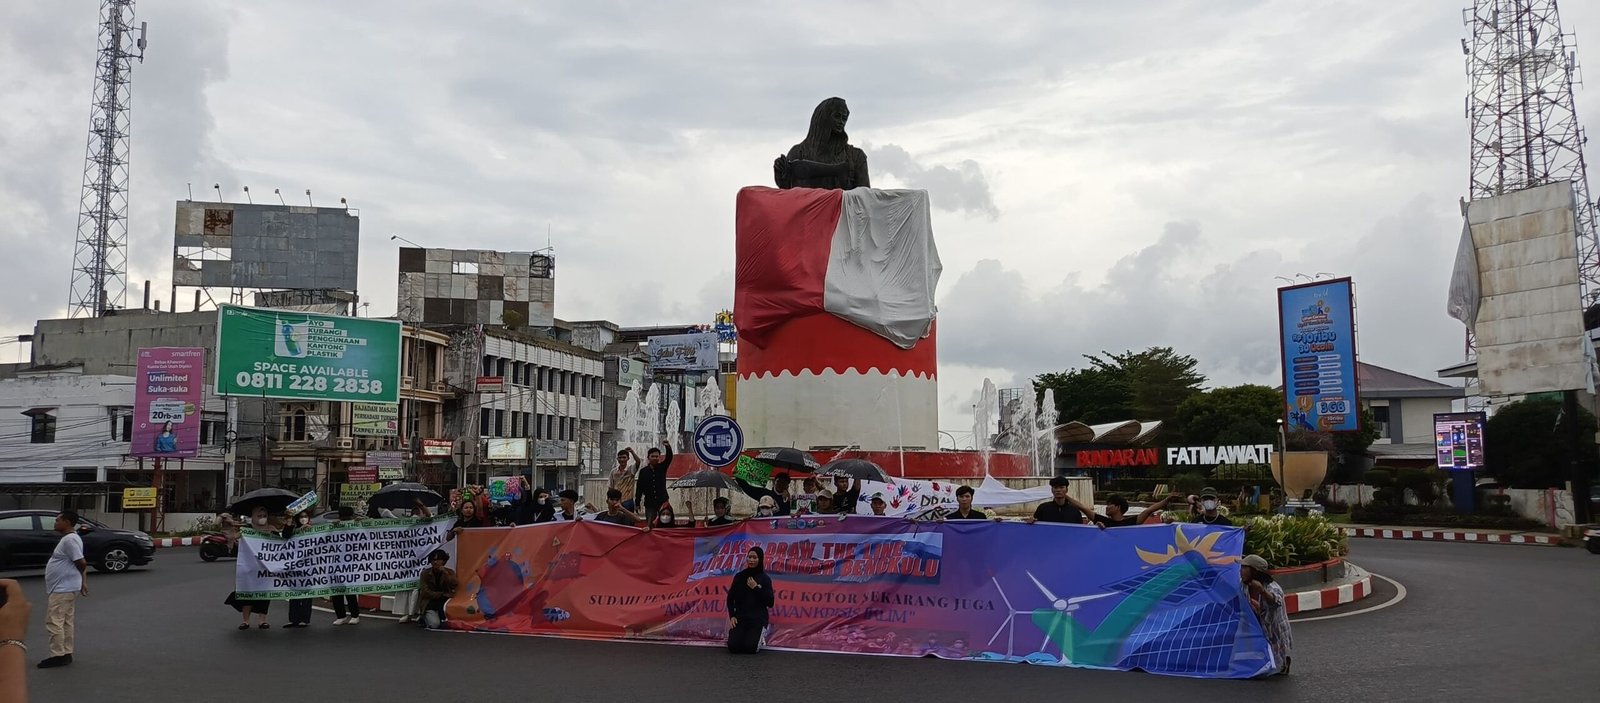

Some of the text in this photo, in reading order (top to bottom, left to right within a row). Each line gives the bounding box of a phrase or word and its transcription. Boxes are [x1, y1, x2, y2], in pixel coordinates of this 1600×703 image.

[308, 336, 360, 344] PENGGUNAAN
[254, 362, 368, 378] SPACE AVAILABLE
[236, 372, 383, 395] 0811 228 2838
[1076, 444, 1273, 468] BUNDARAN FATMAWATI
[257, 535, 441, 562] BUKAN DIRUSAK DEMI KEPENTINGAN
[261, 526, 438, 552] HUTAN SEHARUSNYA DILESTARIKAN
[283, 550, 416, 570] SEGELINTIR ORANG TANPA
[766, 540, 816, 558] DRAW
[822, 542, 858, 560] THE
[328, 562, 373, 574] DAMPAK
[840, 556, 940, 578] BENGKULU
[274, 568, 424, 587] DAN YANG HIDUP DIDALAMNY
[589, 594, 640, 605] SUDAHI
[801, 591, 858, 604] KOTOR
[862, 590, 948, 608] SEKARANG
[954, 598, 994, 611] JUGA
